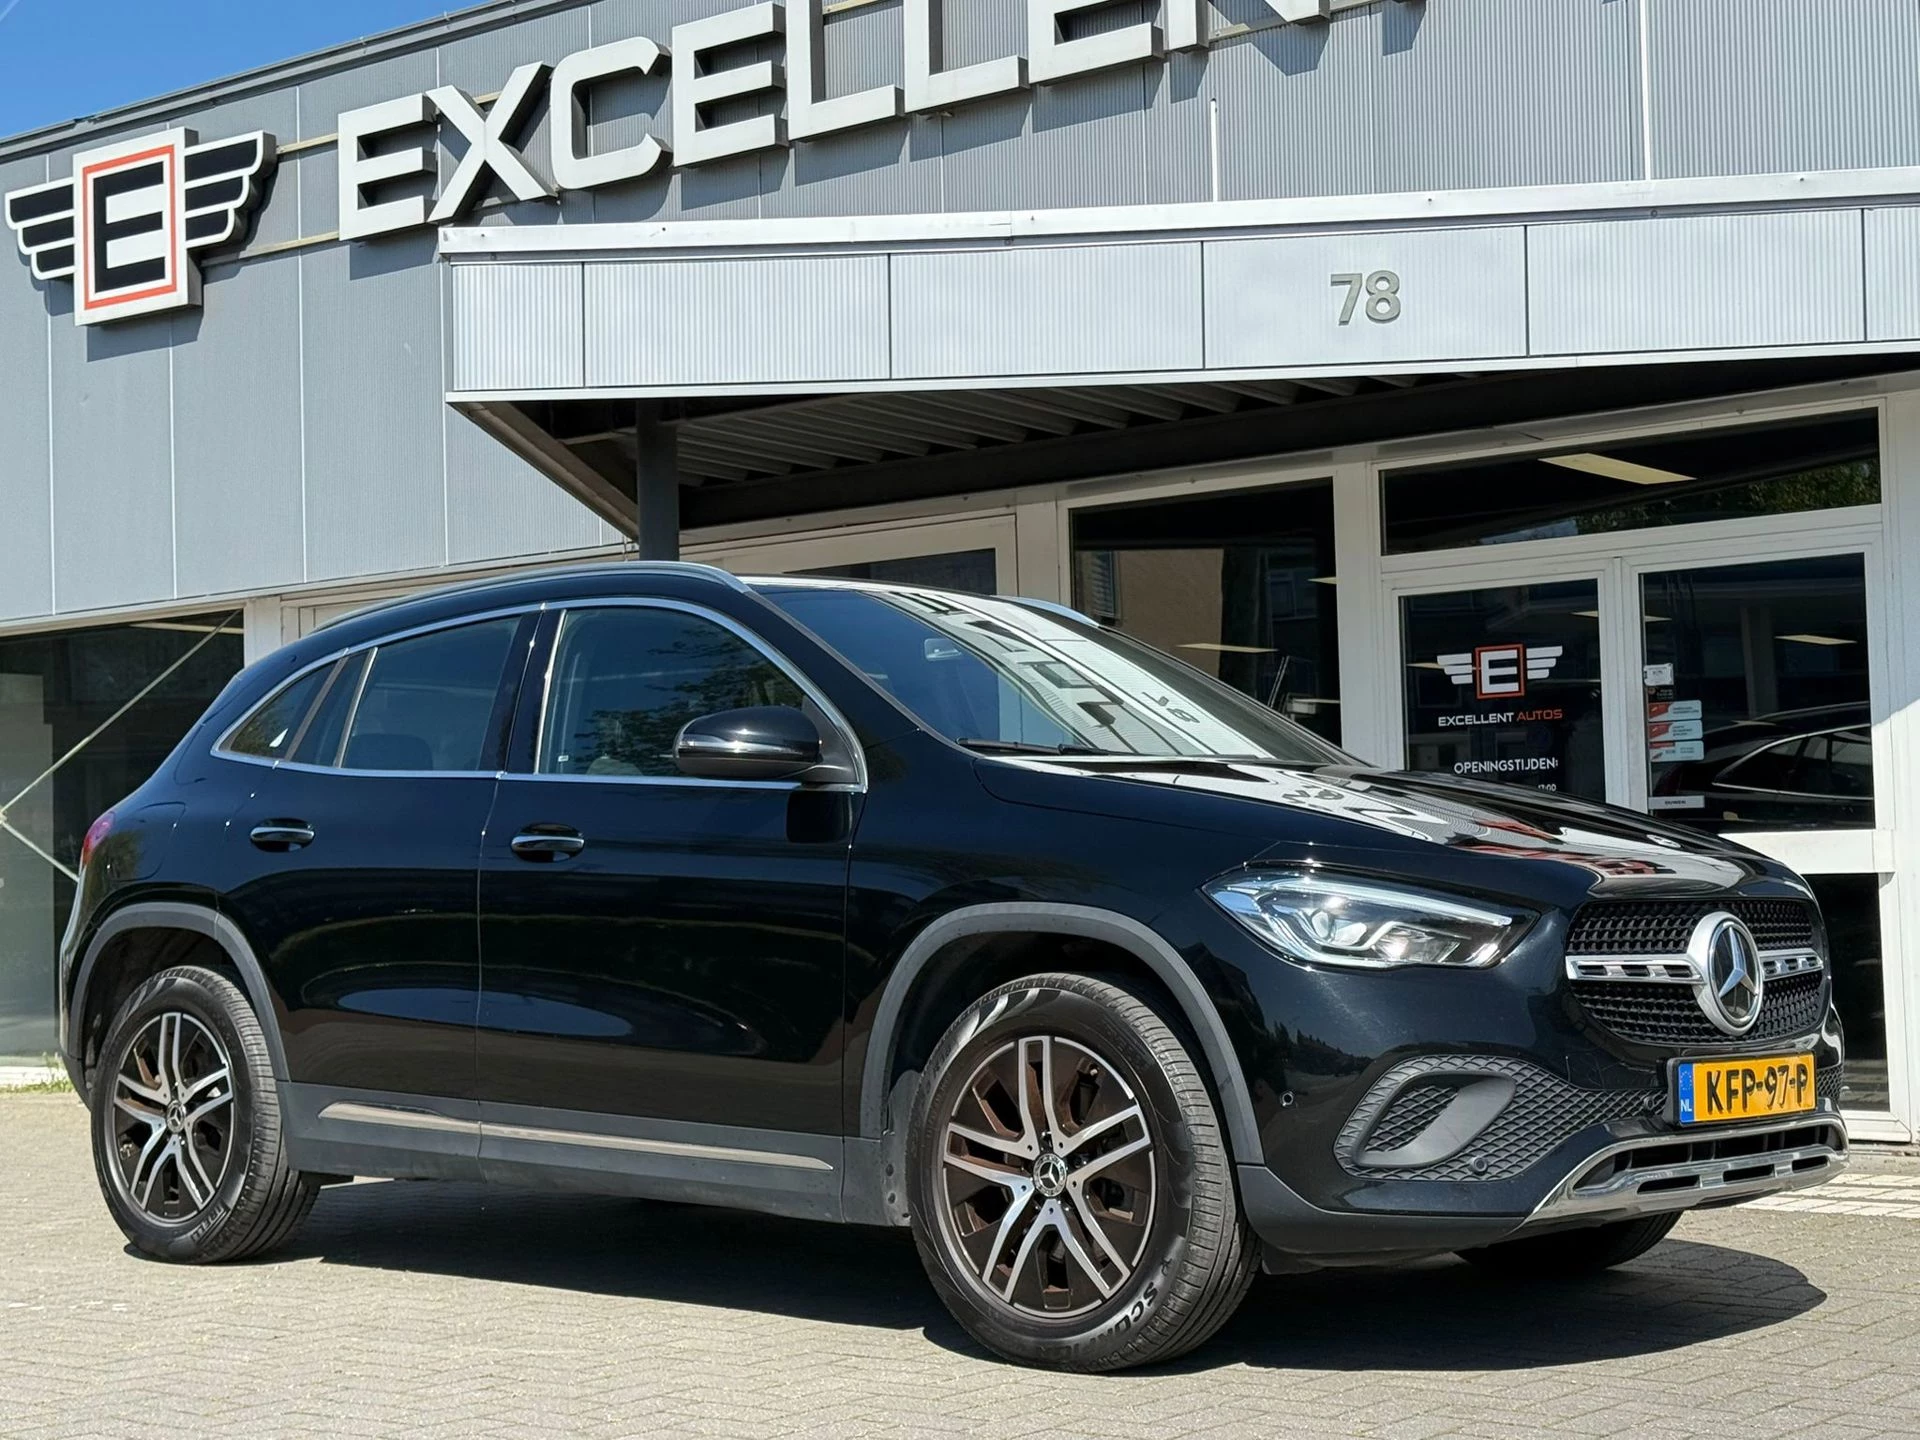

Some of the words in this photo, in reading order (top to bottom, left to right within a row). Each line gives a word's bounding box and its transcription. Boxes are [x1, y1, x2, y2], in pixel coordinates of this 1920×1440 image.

[1330, 270, 1401, 326] 78
[1438, 712, 1514, 727] EXCELLENT
[1516, 709, 1563, 721] AUTOS
[1680, 1098, 1693, 1112] NL
[1706, 1063, 1808, 1114] KFP-97-P
